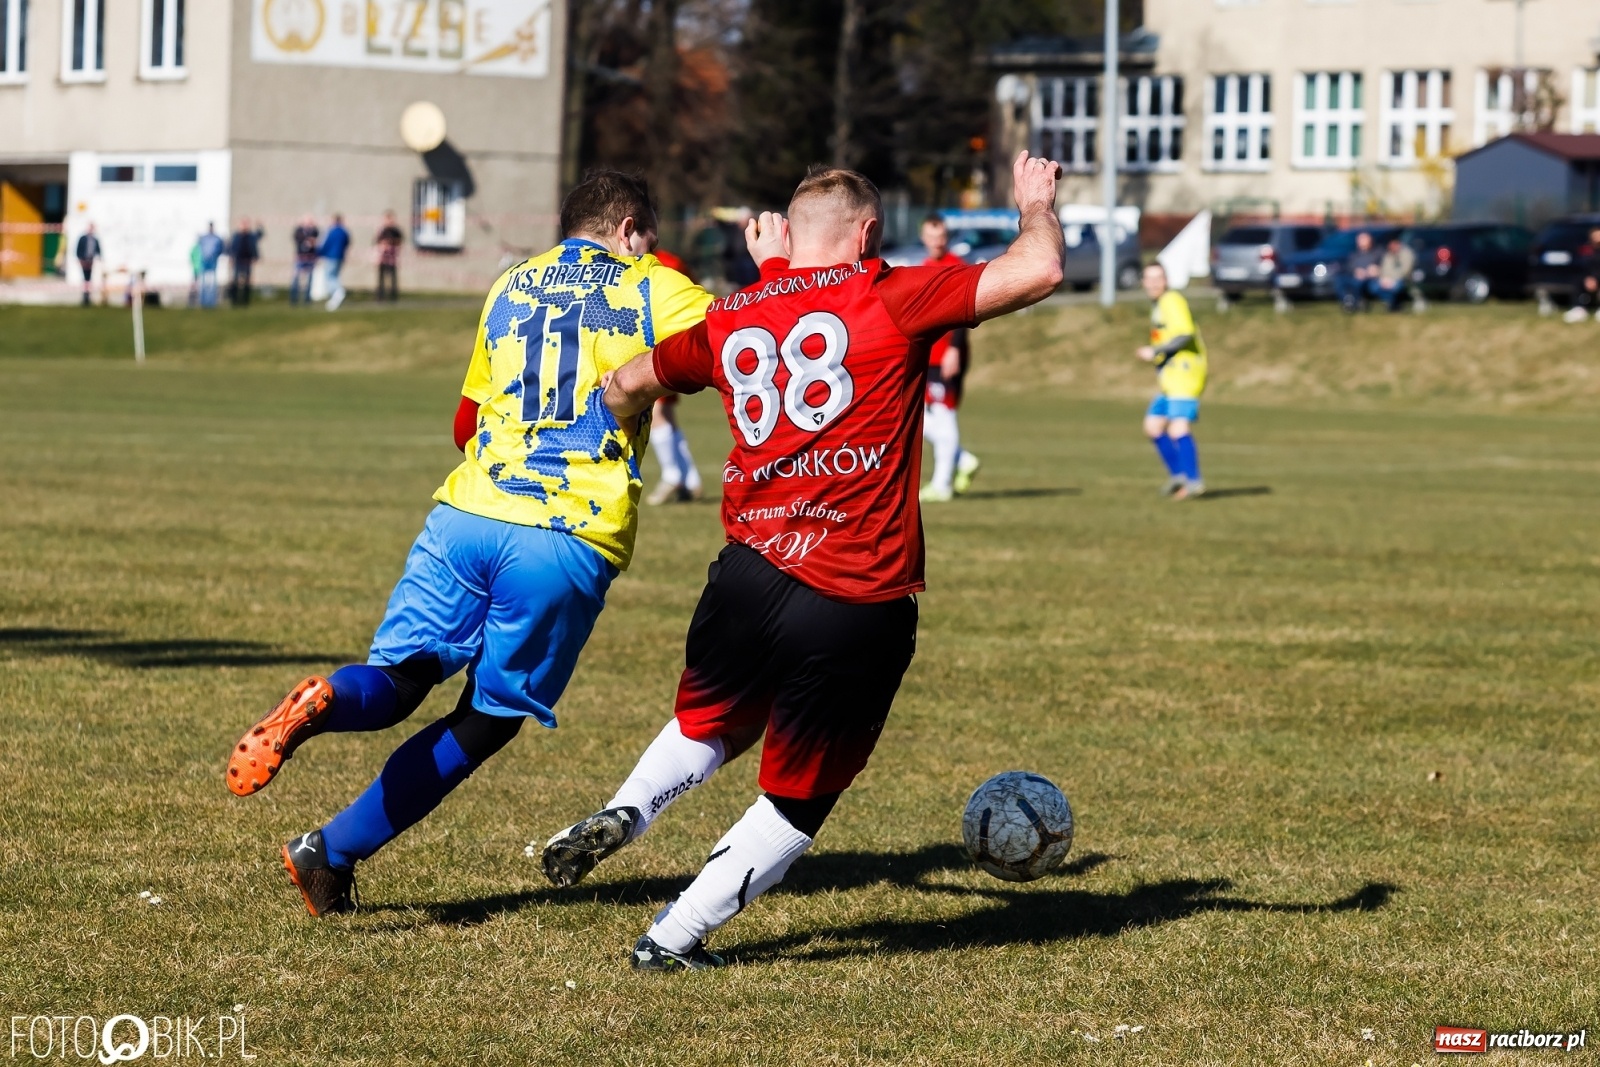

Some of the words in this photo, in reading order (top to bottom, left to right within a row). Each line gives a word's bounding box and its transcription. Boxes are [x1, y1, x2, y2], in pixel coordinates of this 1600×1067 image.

[541, 263, 624, 289] BRZEZIE
[516, 300, 585, 423] 11
[721, 311, 854, 447] 88
[752, 442, 888, 483] WORKÓW
[786, 496, 848, 523] Ślubne
